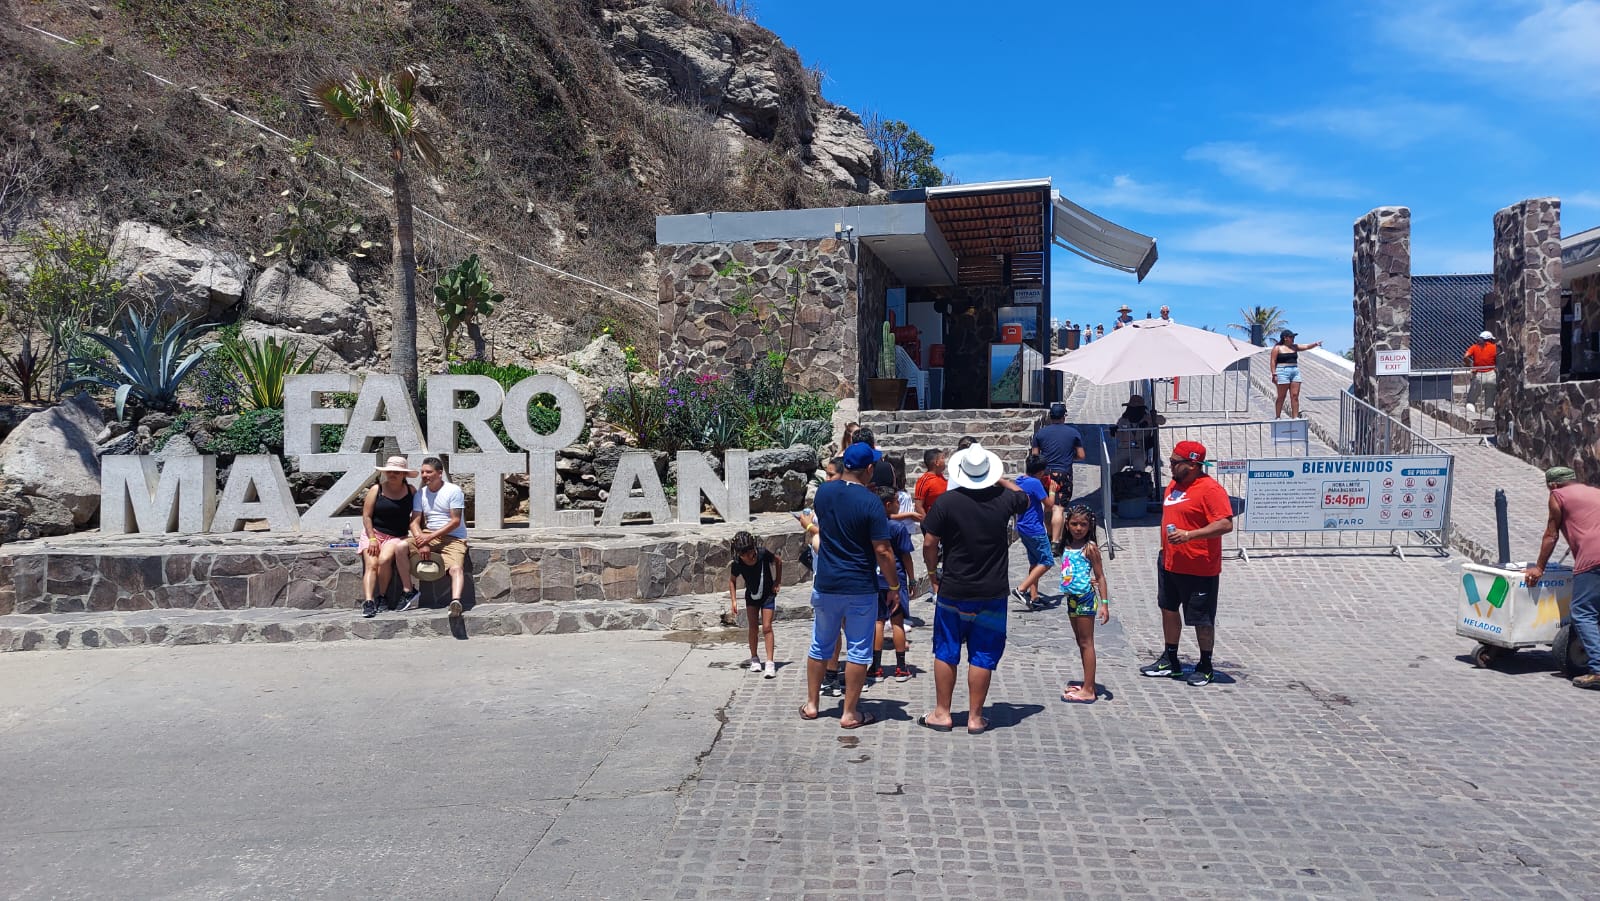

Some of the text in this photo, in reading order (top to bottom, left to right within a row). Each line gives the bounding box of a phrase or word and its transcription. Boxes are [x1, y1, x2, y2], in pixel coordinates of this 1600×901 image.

[283, 374, 587, 453] FARO
[1302, 460, 1393, 474] BIENVENIDOS
[1324, 494, 1366, 507] 5:45pm
[1338, 518, 1364, 526] FARO
[1519, 579, 1565, 588] HADOS
[1463, 617, 1502, 634] HELADOS
